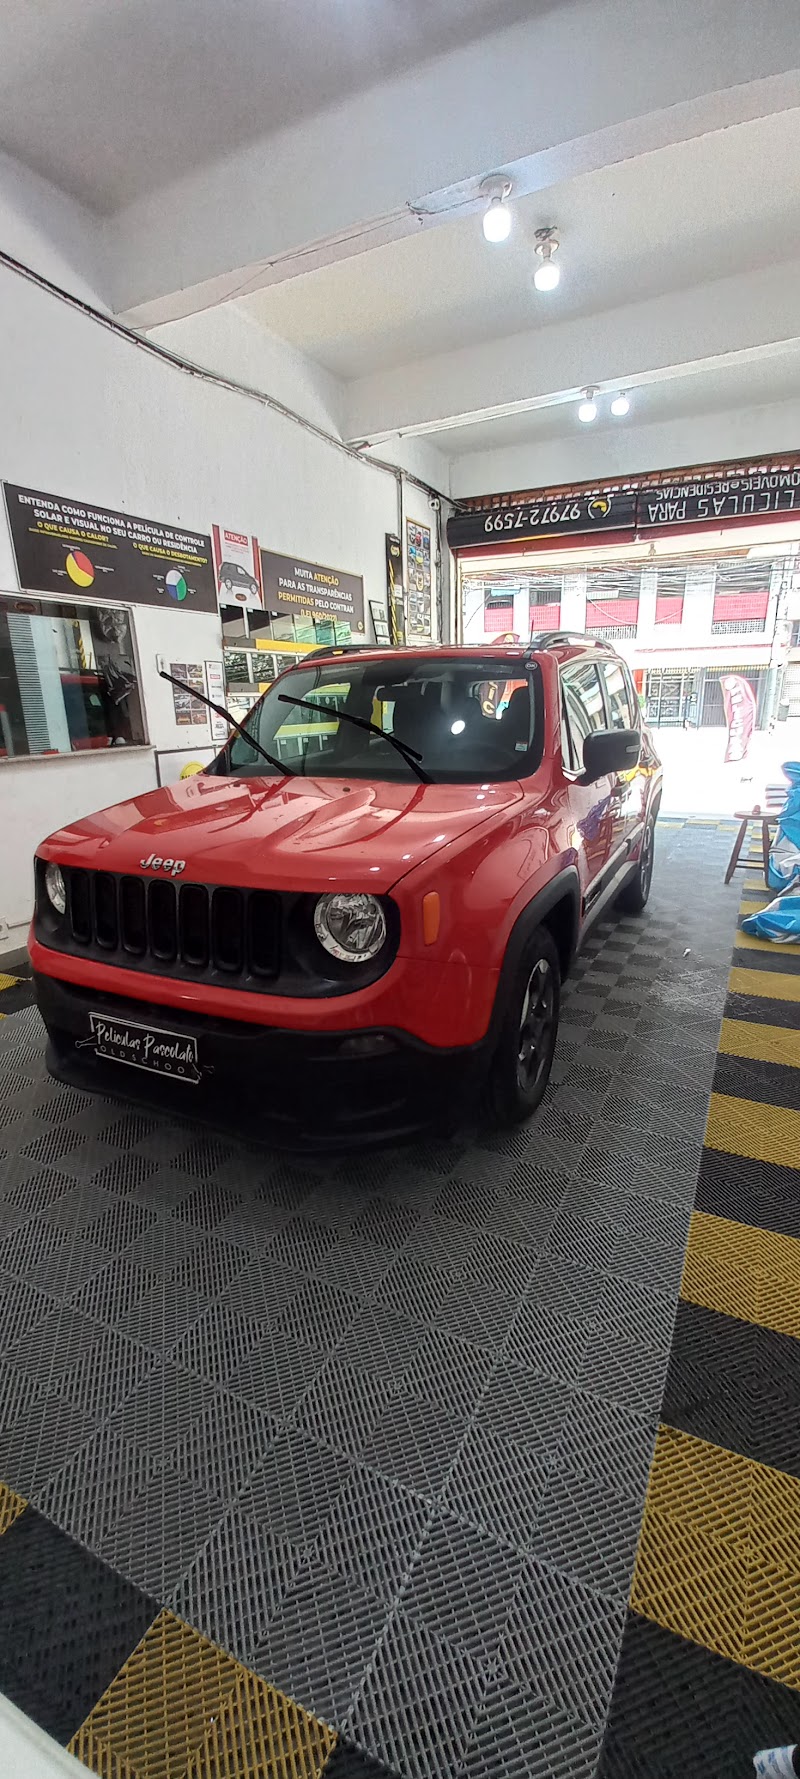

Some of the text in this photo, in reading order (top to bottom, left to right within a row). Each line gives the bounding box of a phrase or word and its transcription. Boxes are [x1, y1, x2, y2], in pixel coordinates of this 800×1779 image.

[18, 494, 205, 548] ENTENDA COMO FUNCIONA A PELÍCULA DE CONTROLE
[484, 503, 581, 532] 97972-7599
[648, 500, 686, 523] PARA
[33, 508, 63, 523] SOLAR
[64, 515, 70, 525] E
[71, 517, 99, 532] VISUAL
[100, 525, 112, 534] NO
[113, 528, 126, 538] SEU
[127, 531, 151, 544] CARRO
[152, 537, 162, 546] OU
[162, 539, 198, 555] RESIDÊNCIA
[36, 521, 43, 529] O
[44, 523, 58, 532] QUE
[58, 526, 80, 537] CAUSA
[138, 544, 149, 552] QUE
[149, 546, 167, 556] CAUSA
[294, 567, 339, 587] MUITA ATENÇÃO
[278, 577, 352, 602] PARA AS TRANSPARÊNCIAS
[278, 591, 354, 614] PERMITIDAS PELO CONTRAN
[140, 853, 186, 877] Jeep
[96, 1021, 141, 1051] Peliculas
